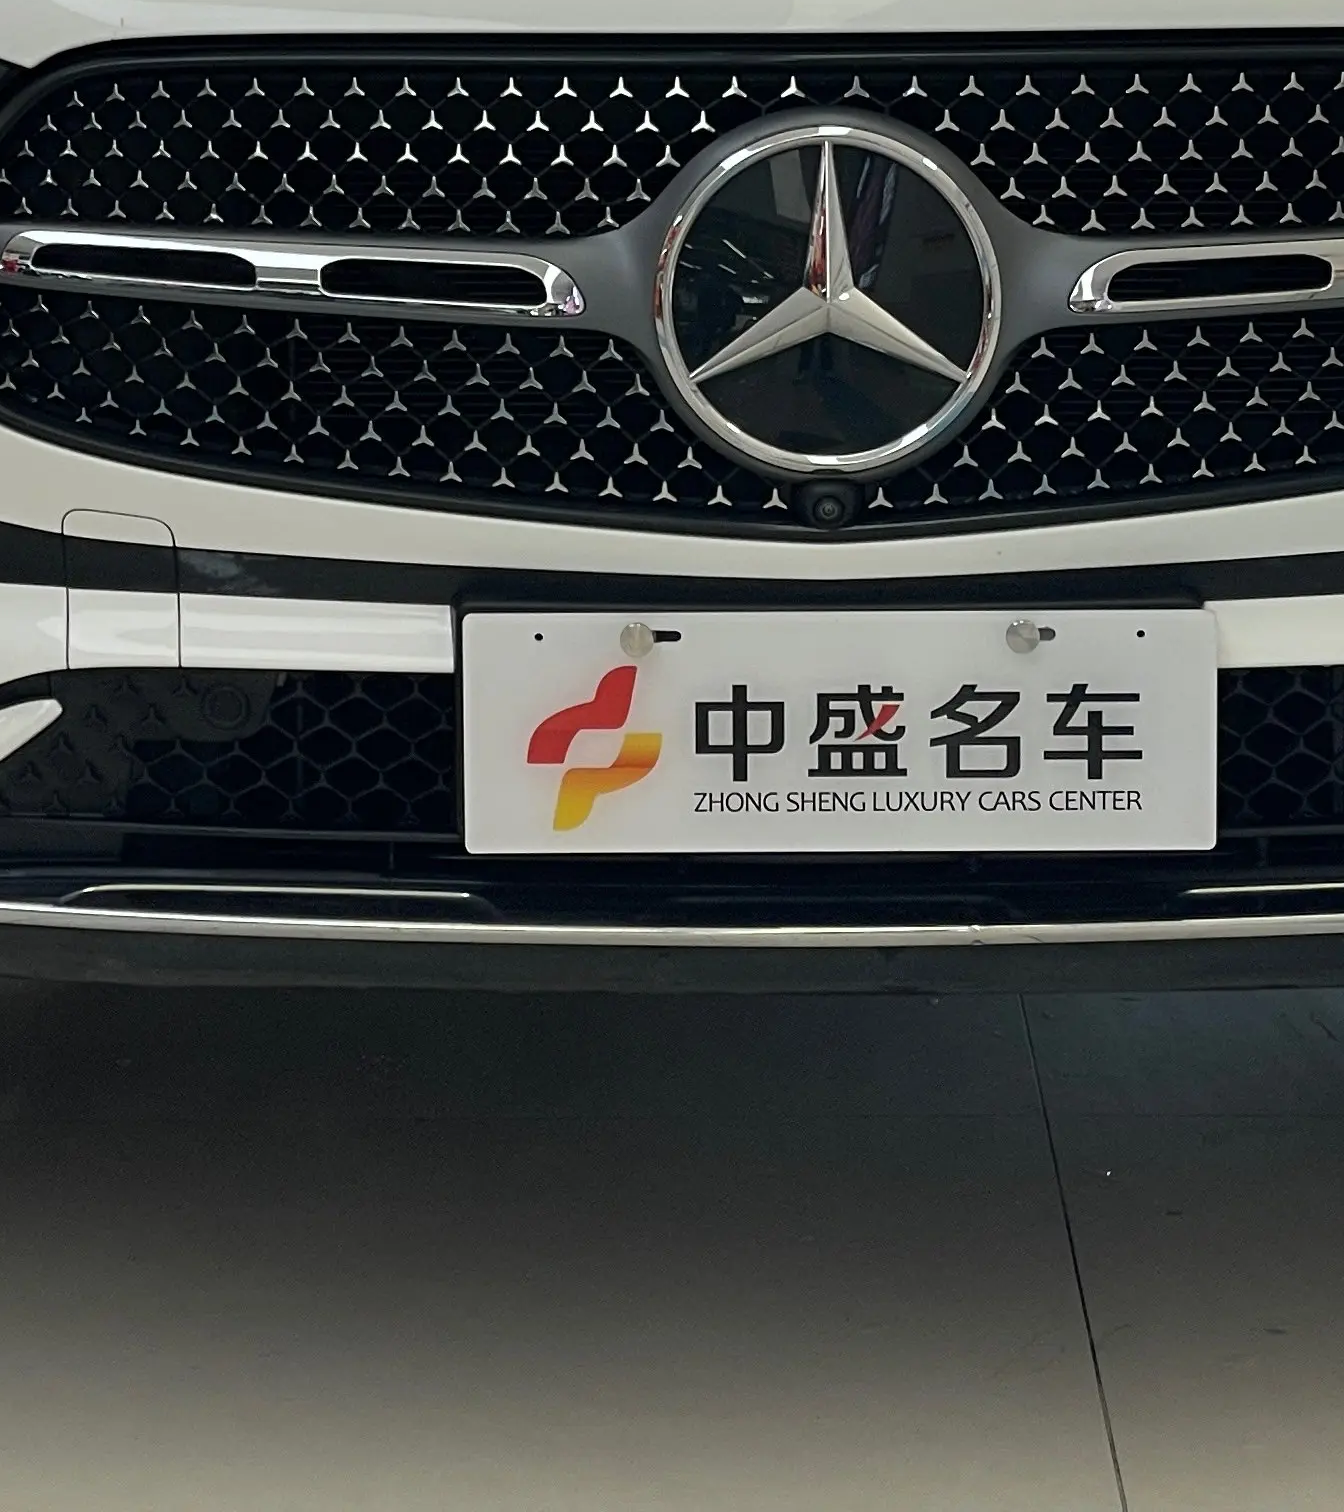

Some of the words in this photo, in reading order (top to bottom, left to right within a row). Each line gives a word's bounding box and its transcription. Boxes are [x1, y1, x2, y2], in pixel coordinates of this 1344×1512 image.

[694, 683, 1143, 782] 中盛名车
[694, 791, 779, 813] ZHONG
[786, 791, 865, 813] SHENG
[873, 791, 971, 812] LUXURY
[979, 790, 1042, 812] CARS
[1049, 790, 1143, 812] CENTER
